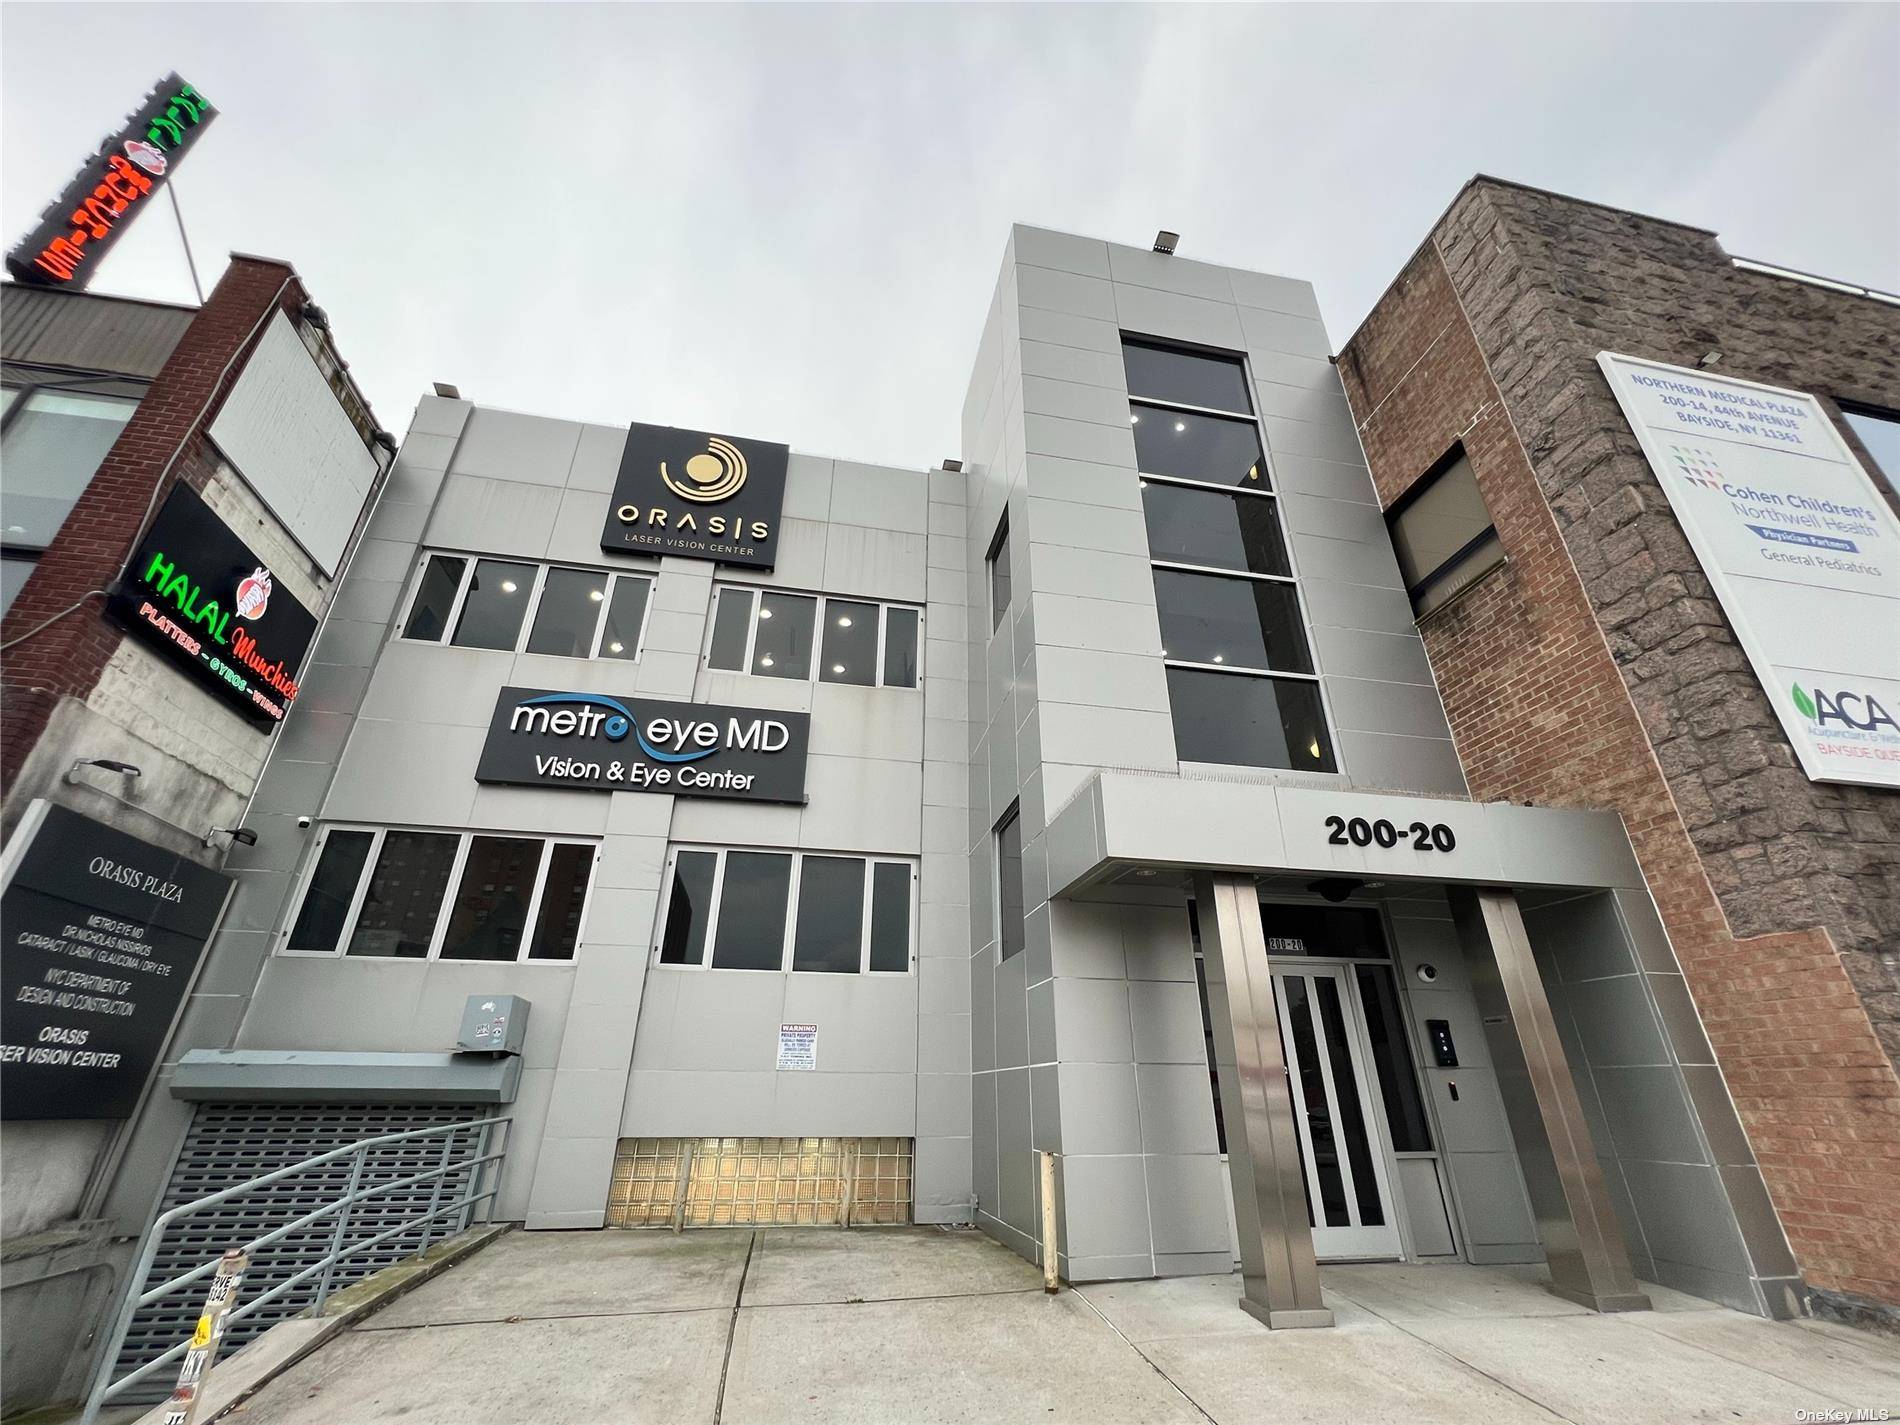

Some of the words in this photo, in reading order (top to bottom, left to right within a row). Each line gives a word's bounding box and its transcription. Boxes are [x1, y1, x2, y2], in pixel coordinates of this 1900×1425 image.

[1631, 374, 1707, 398] NORTHERN
[1708, 390, 1766, 410] MEDICAL
[1765, 402, 1808, 418] PLAZA
[1659, 394, 1713, 414] 200-14,
[1714, 405, 1746, 419] 44th
[1748, 411, 1801, 430] AVENUE
[1676, 411, 1738, 433] BAYSIDE,
[1739, 423, 1759, 436] NY
[1722, 483, 1784, 506] Cohen
[1786, 494, 1877, 522] Children's
[1730, 501, 1822, 529] Northwell
[1823, 516, 1880, 538] Health
[617, 505, 768, 540] ORASIS
[624, 533, 662, 545] LASER
[667, 538, 705, 550] VISION
[710, 544, 755, 556] CENTER
[1760, 548, 1815, 566] General
[1817, 556, 1882, 577] Pediatrics
[144, 552, 230, 646] HALAL
[139, 601, 202, 656] PLATTERS
[209, 657, 247, 692] GYROS
[252, 689, 284, 720] WINGS
[231, 626, 299, 701] Munchies
[646, 717, 719, 751] eye
[726, 717, 790, 752] MD
[1817, 742, 1873, 758] BAYSIDE
[535, 754, 600, 780] Vision
[607, 760, 625, 781] &
[630, 762, 671, 788] Eye
[677, 766, 755, 790] Center
[1325, 815, 1456, 852] 200-20
[89, 856, 143, 888] ORASIS
[141, 875, 183, 903] PLAZA
[86, 914, 117, 932] METRO
[116, 922, 134, 936] EYE
[132, 927, 144, 939] MD
[1270, 938, 1302, 950] 200-20
[17, 931, 67, 953] CATARACT
[68, 944, 97, 960] LASIK
[97, 950, 139, 969] GLAUCOMA
[141, 960, 158, 975] DRY
[157, 963, 172, 977] EYE
[43, 967, 67, 985] NYC
[65, 972, 121, 994] DEPARTMENT
[118, 981, 132, 996] OF
[15, 986, 56, 1005] DESIGN
[53, 991, 76, 1008] AND
[72, 994, 136, 1017] CONSTRUCTION
[38, 1026, 90, 1045] ORASIS
[26, 1047, 73, 1065] VISION
[72, 1051, 121, 1068] CENTER
